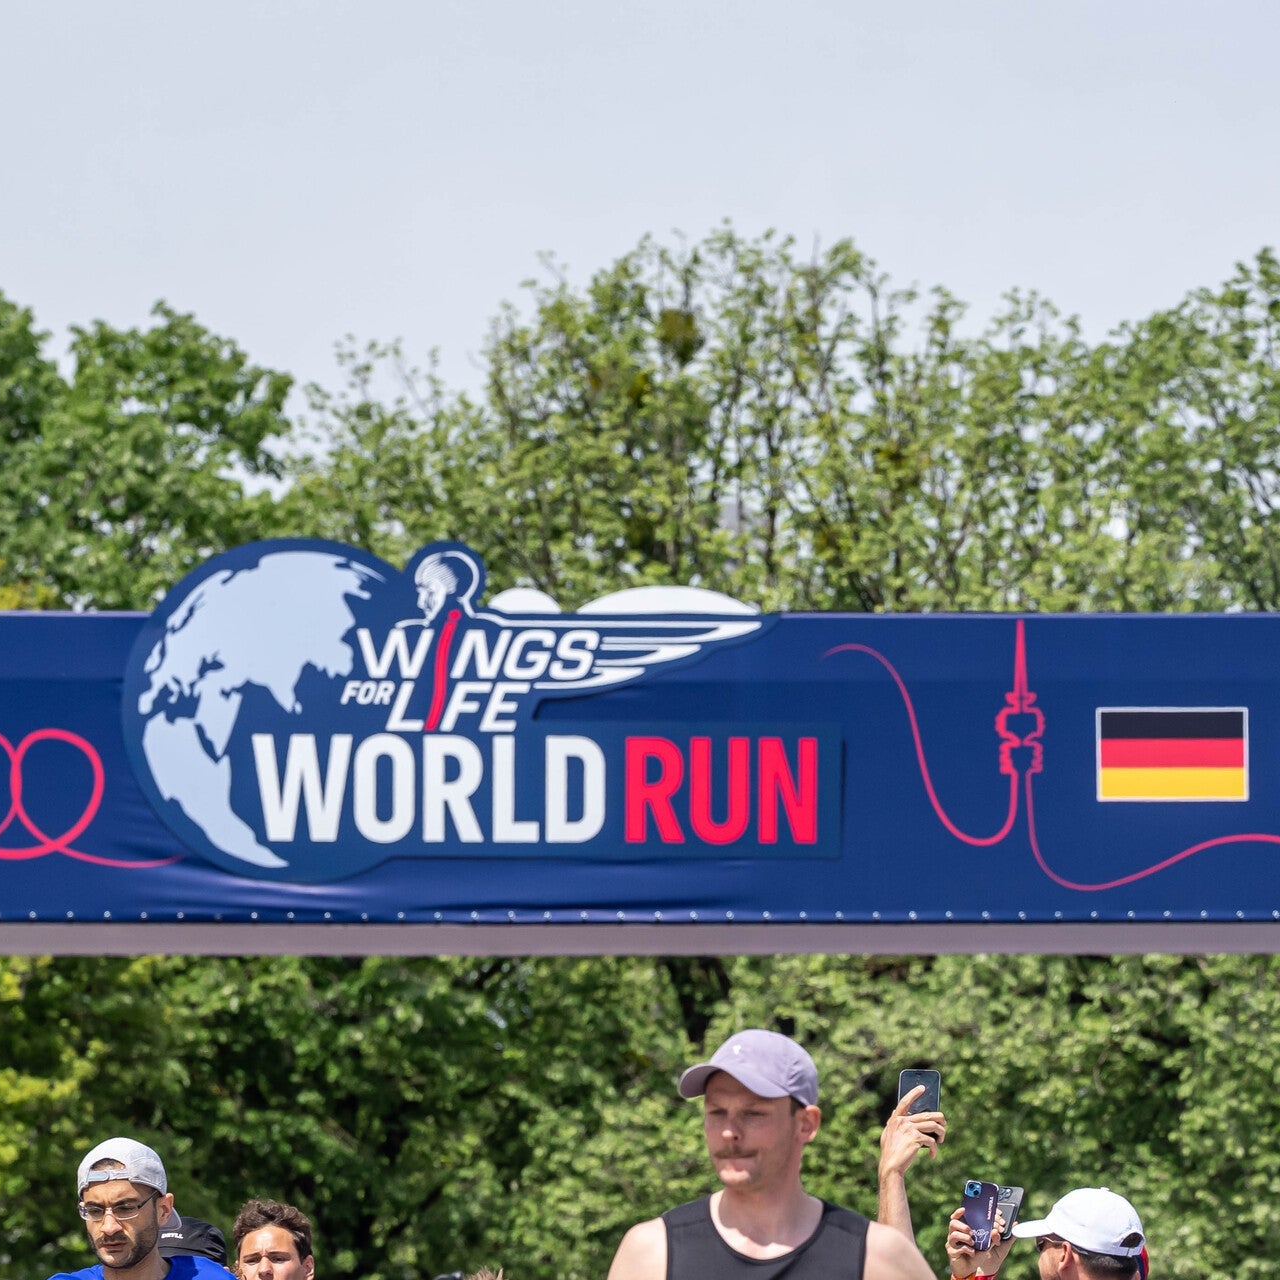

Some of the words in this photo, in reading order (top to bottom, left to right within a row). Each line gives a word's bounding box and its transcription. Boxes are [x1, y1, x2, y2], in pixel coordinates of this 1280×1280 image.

[356, 627, 600, 680] WINGS
[340, 681, 395, 706] FOR
[386, 681, 535, 732] LIFE
[251, 733, 606, 844] WORLD
[625, 736, 818, 845] RUN
